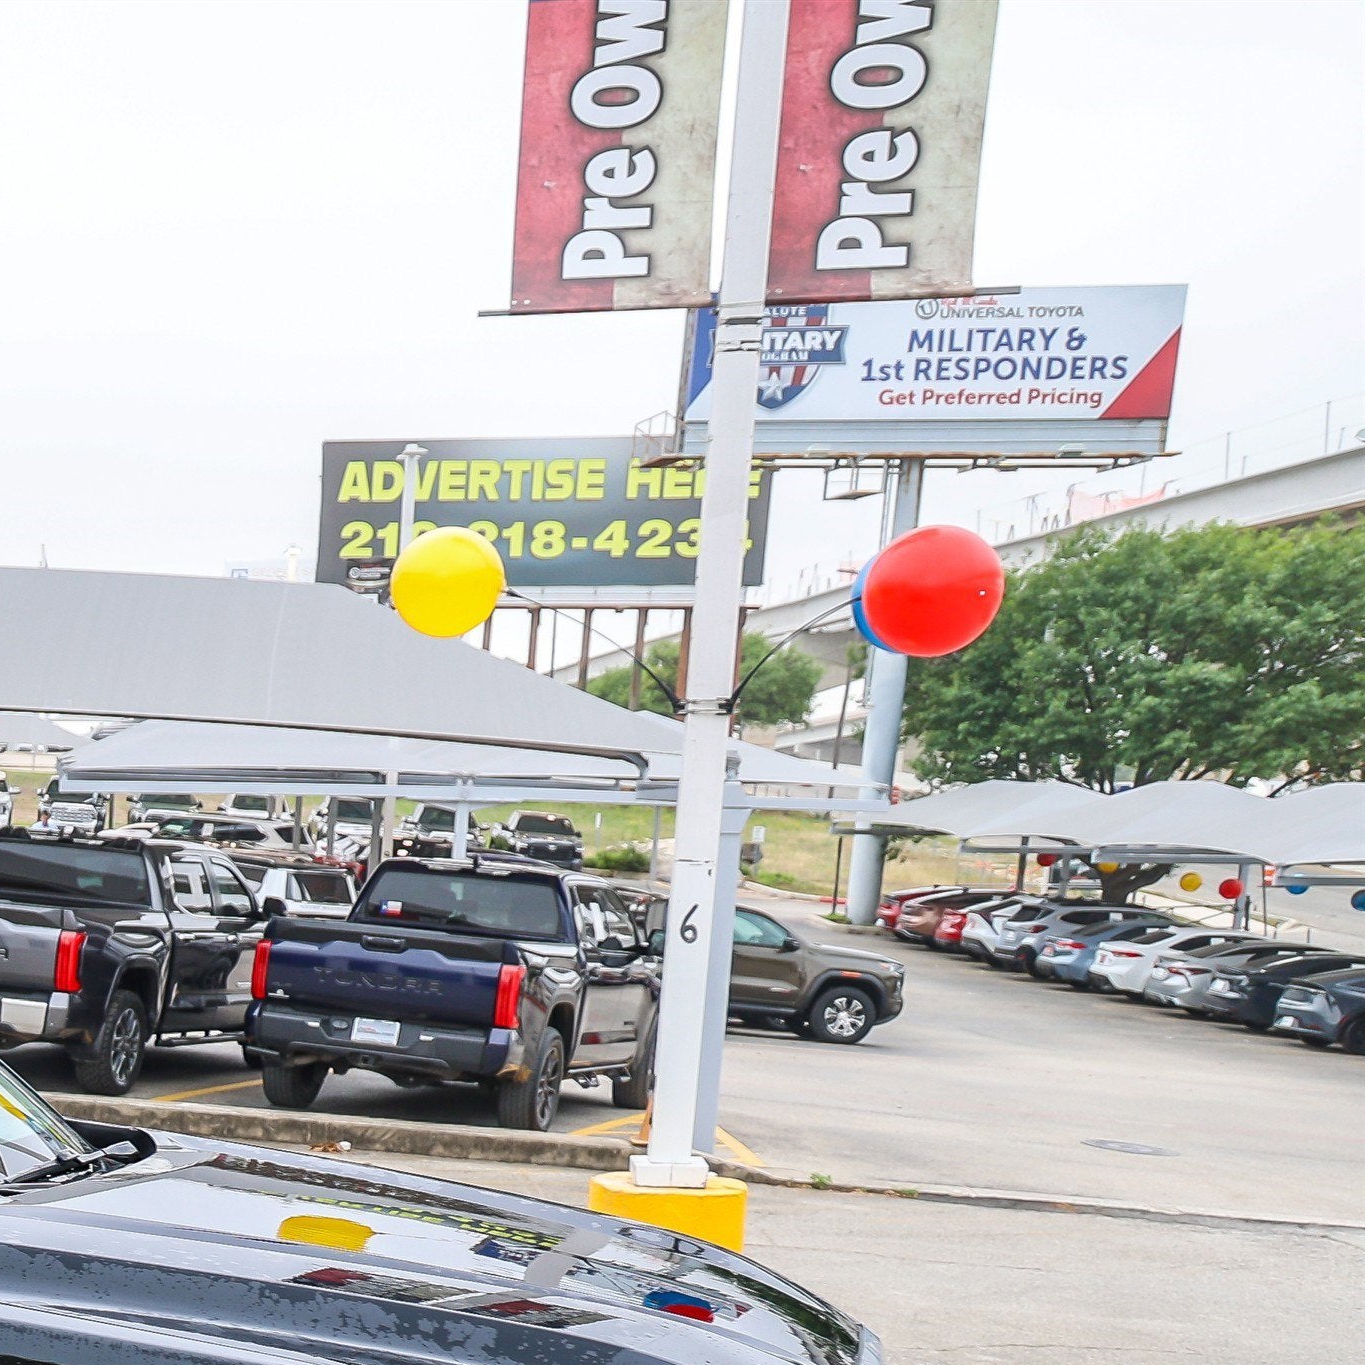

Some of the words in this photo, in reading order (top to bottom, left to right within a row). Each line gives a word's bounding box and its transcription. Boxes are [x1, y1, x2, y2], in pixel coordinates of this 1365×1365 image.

[816, 130, 919, 270] Pre
[561, 148, 658, 280] Pre
[763, 306, 807, 316] ALUTE
[940, 306, 1024, 319] UNIVERSAL
[1028, 306, 1084, 318] TOYOTA
[907, 326, 1059, 352] MILITARY
[1065, 325, 1087, 351] &
[861, 357, 905, 381] 1st
[913, 355, 1129, 381] RESPONDERS
[878, 388, 916, 405] Get
[922, 387, 1022, 405] Preferred
[1028, 387, 1103, 408] Pricing
[338, 458, 607, 503] ADVERTISE
[680, 903, 699, 944] 6
